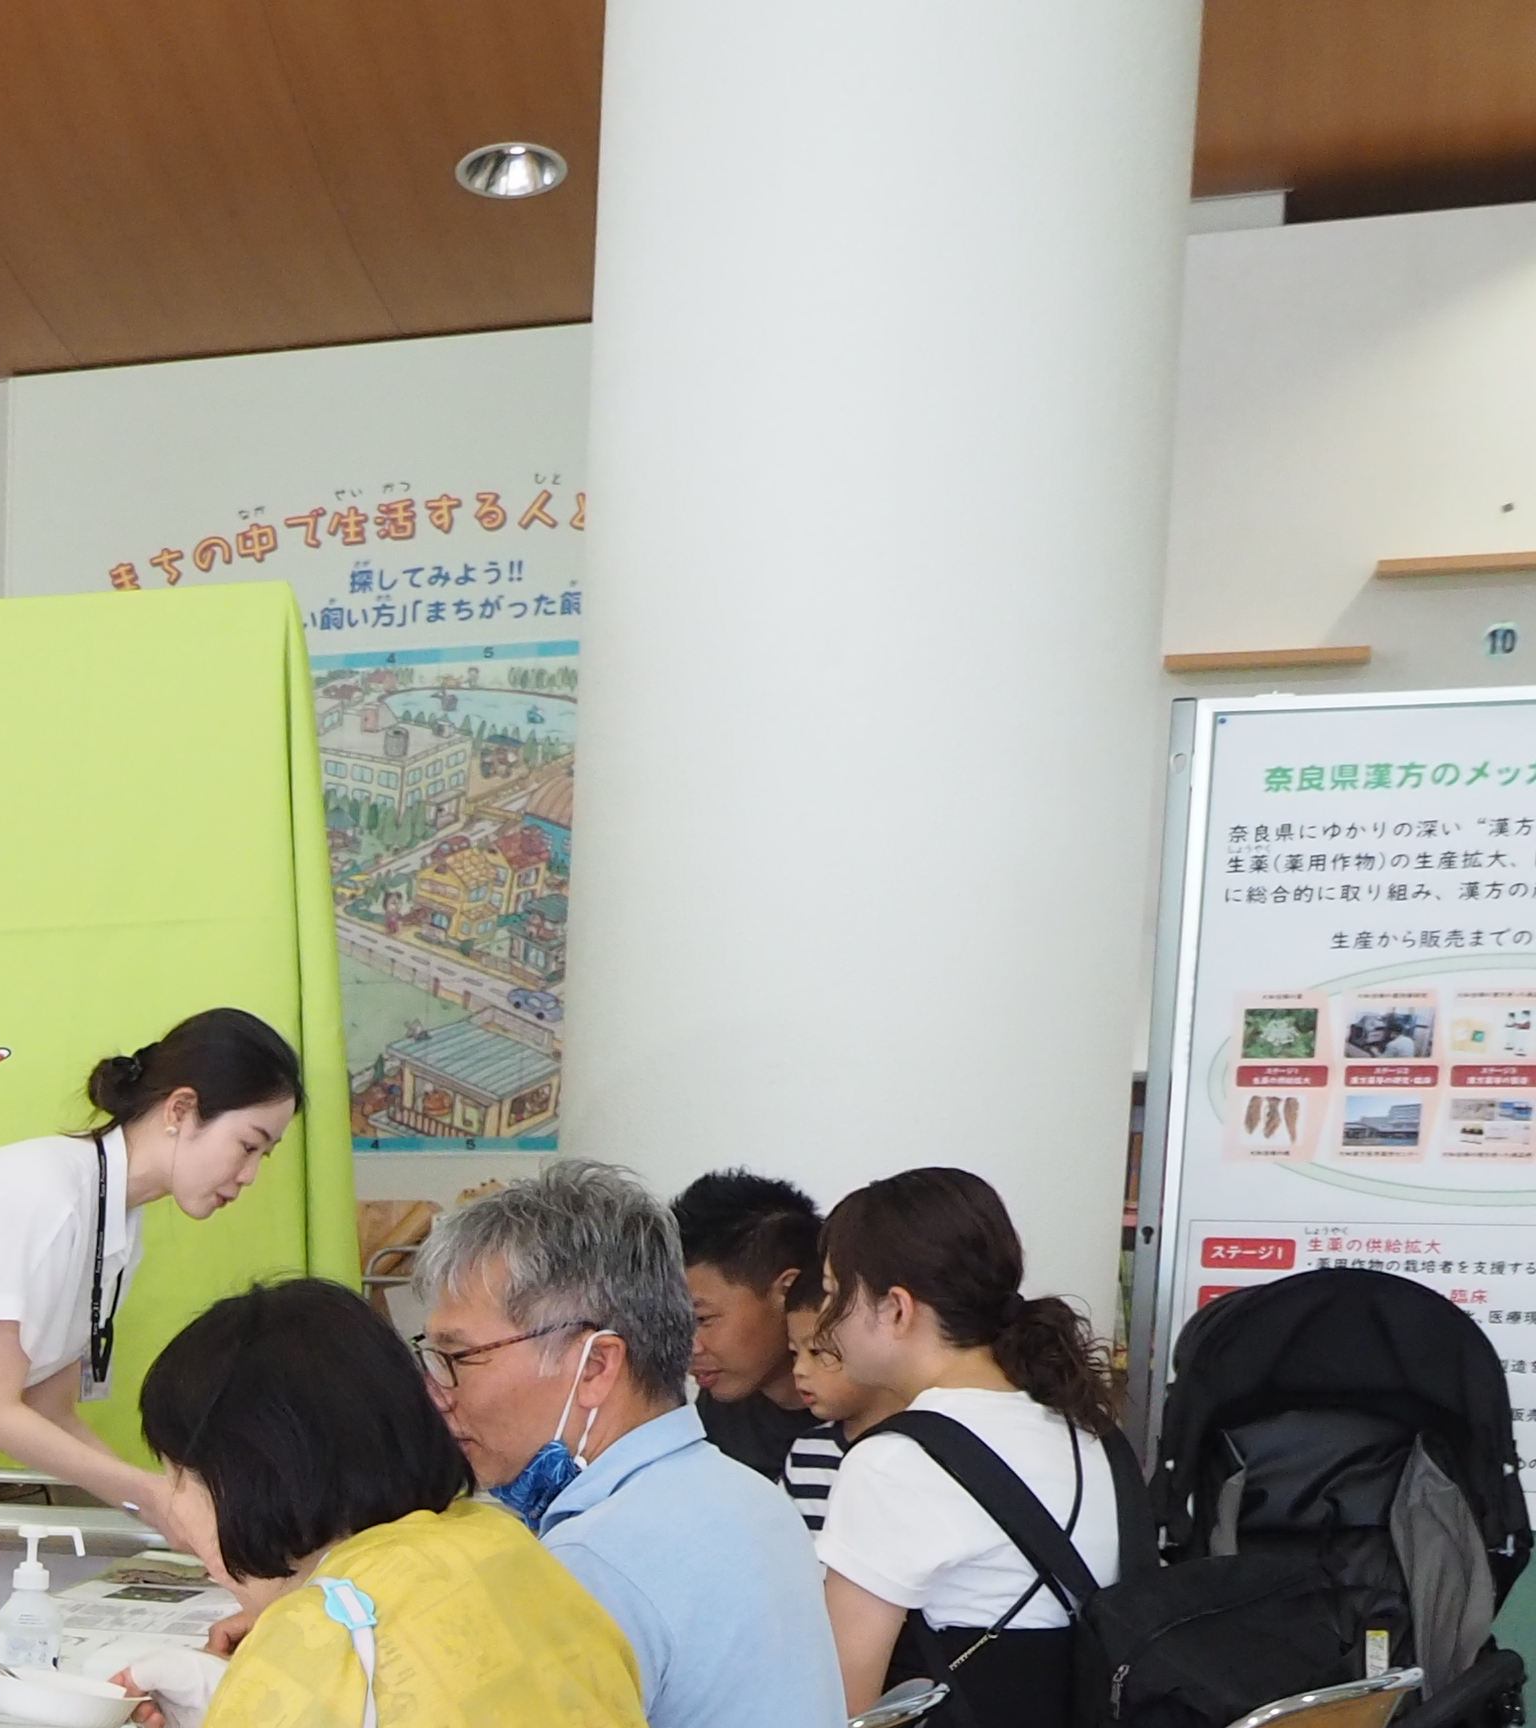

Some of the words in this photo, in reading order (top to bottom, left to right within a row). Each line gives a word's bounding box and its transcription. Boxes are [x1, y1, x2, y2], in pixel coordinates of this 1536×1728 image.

[1487, 628, 1516, 655] 10
[386, 652, 396, 663] 4
[483, 647, 494, 659] 5
[1226, 851, 1536, 875] 生薬(薬用作物)の生産拡大、
[1224, 881, 1536, 905] に総合的に取り組み、漢方の
[1330, 929, 1533, 951] 生産から販売までの
